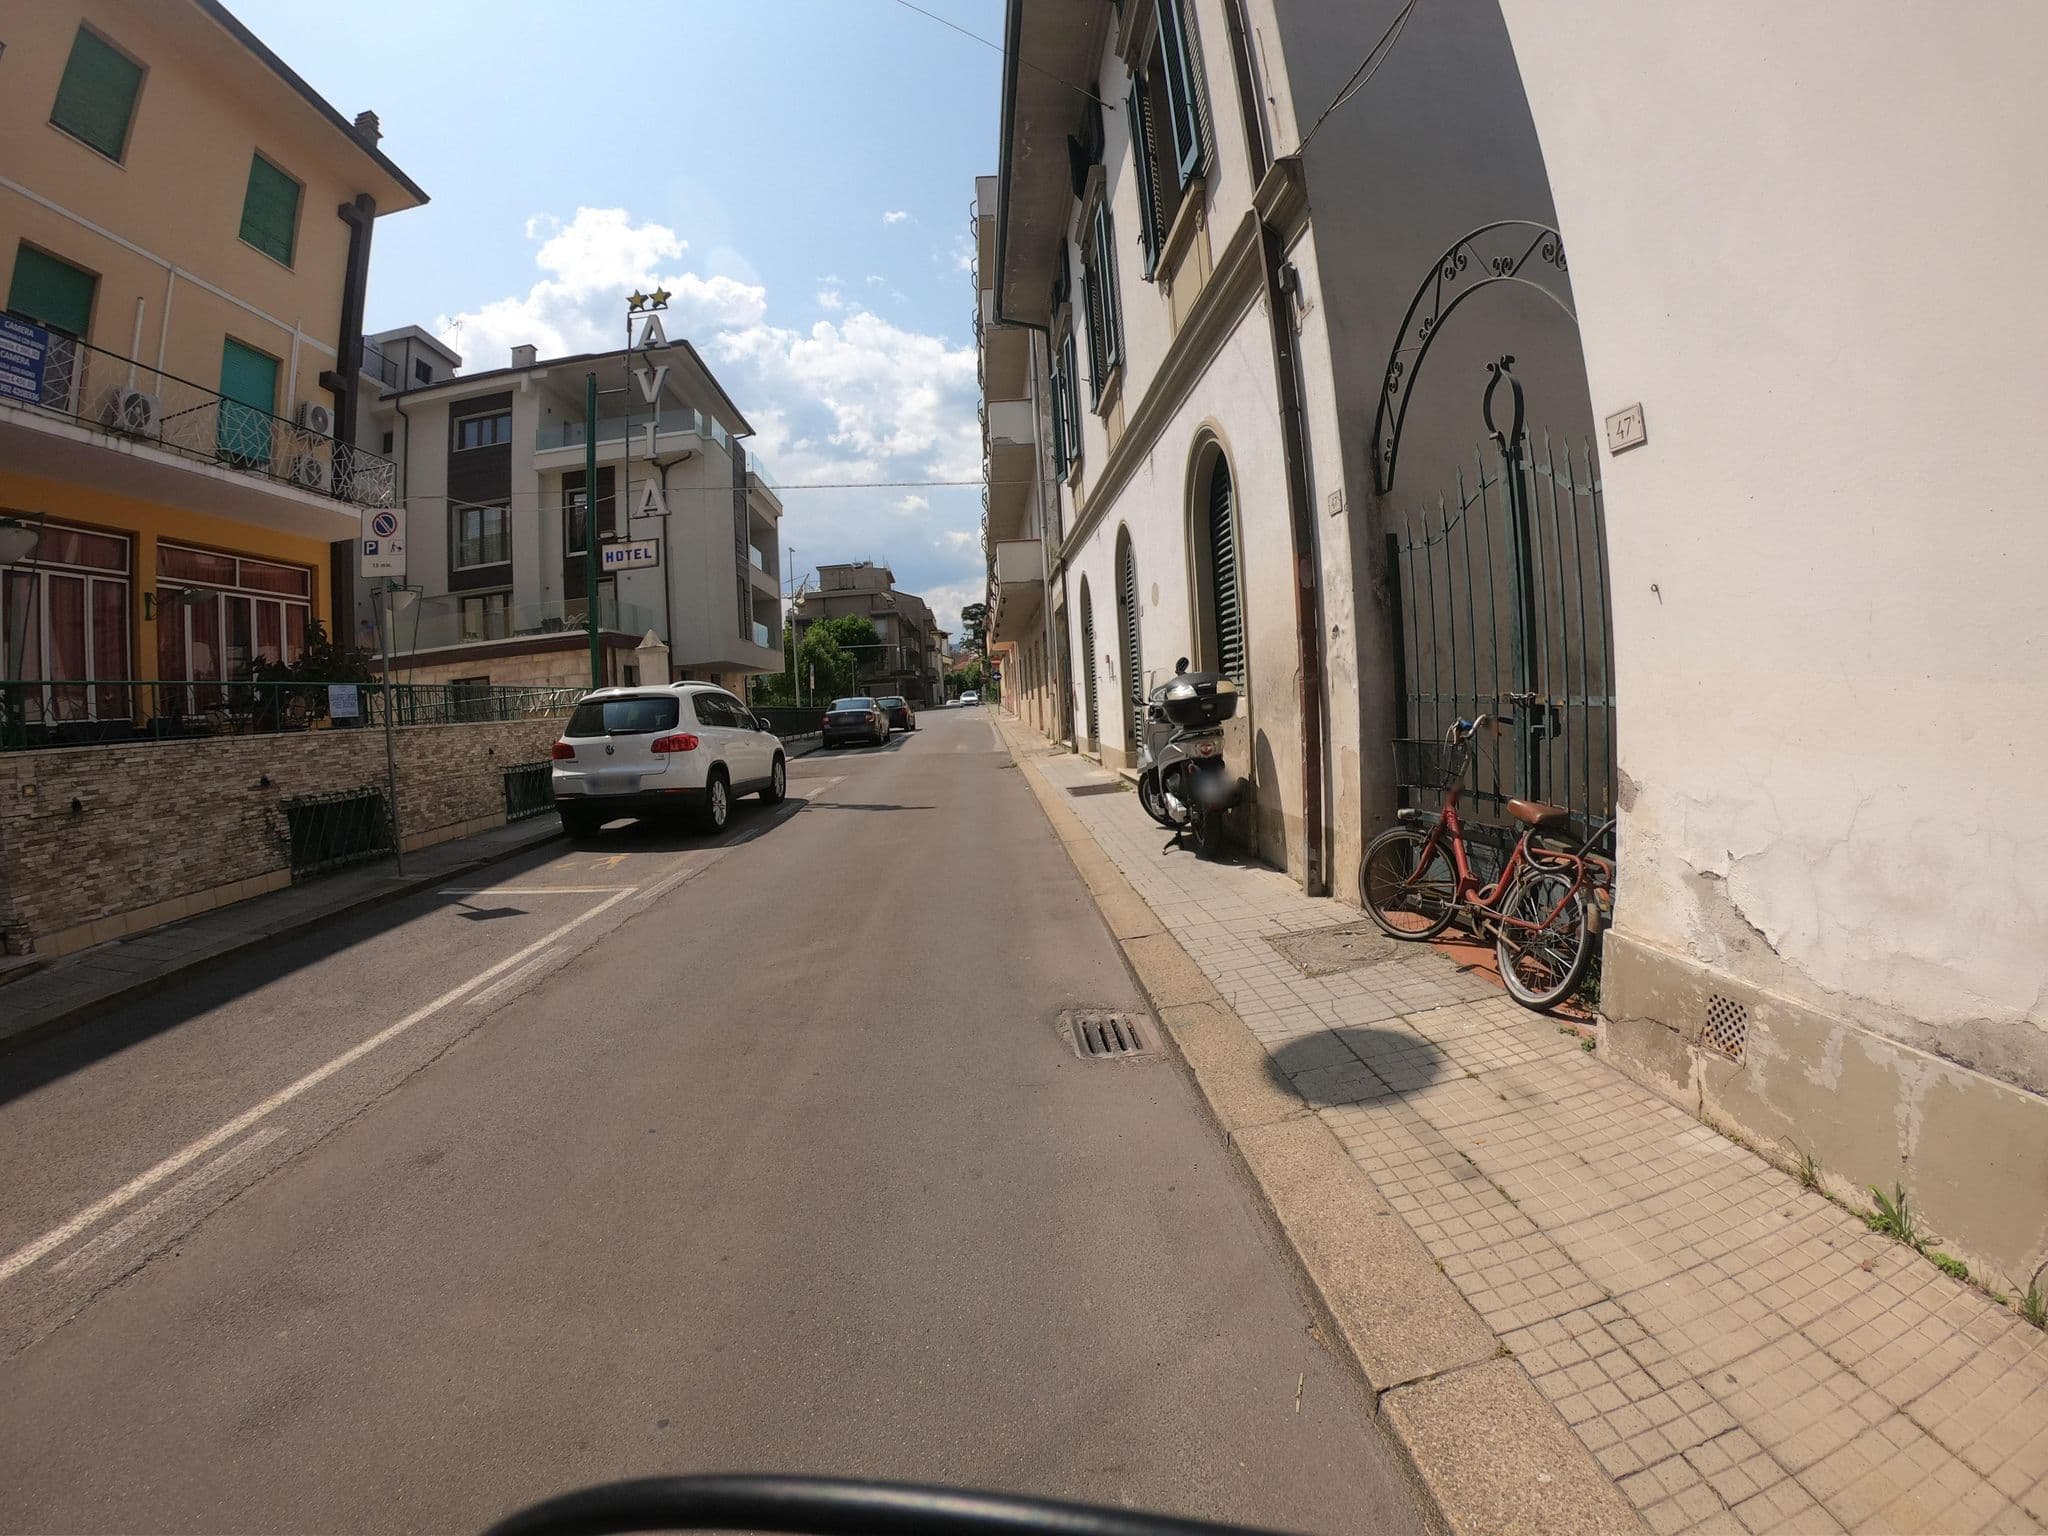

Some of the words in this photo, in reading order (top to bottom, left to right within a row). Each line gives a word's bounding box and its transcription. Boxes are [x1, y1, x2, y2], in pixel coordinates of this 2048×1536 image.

[4, 320, 34, 338] CAMERA
[0, 350, 30, 366] CAMERA
[632, 314, 671, 518] AVIA
[1616, 415, 1631, 439] 47
[366, 541, 377, 554] P
[606, 548, 652, 562] HOTEL
